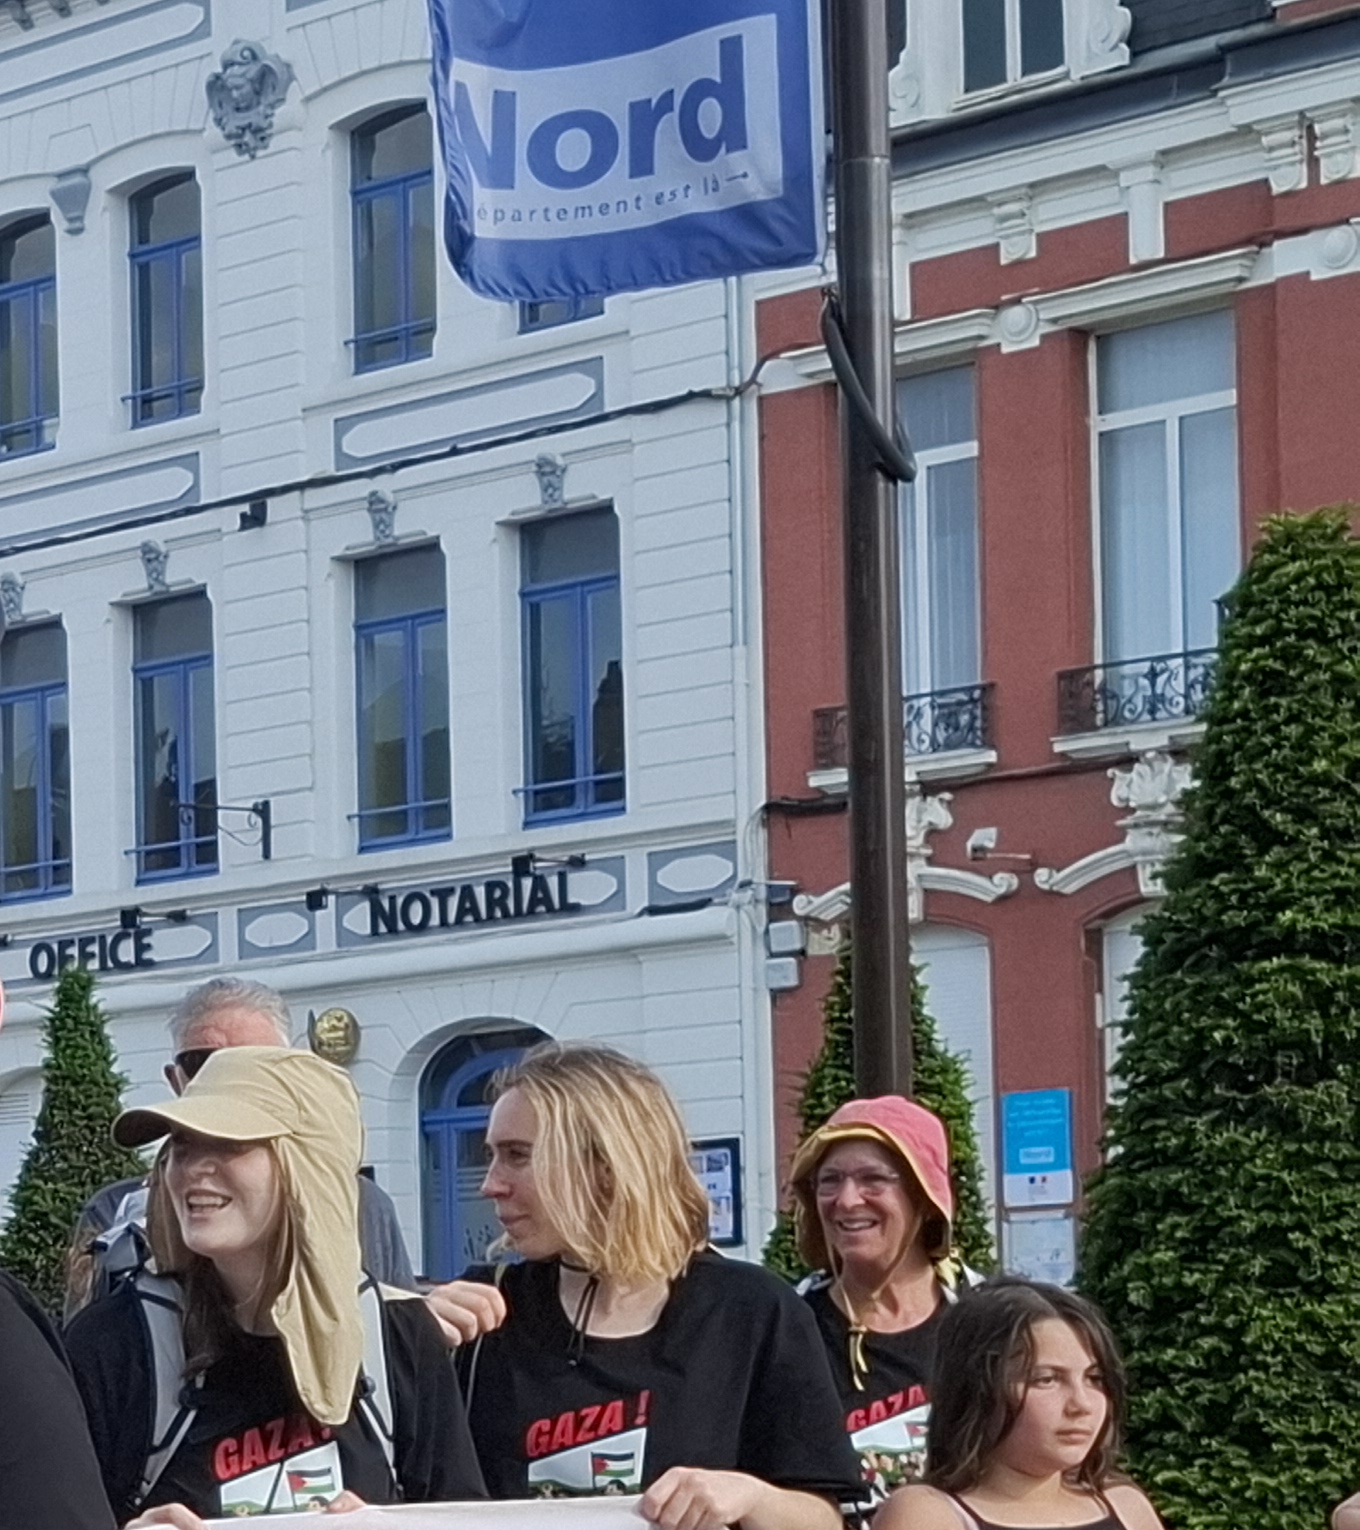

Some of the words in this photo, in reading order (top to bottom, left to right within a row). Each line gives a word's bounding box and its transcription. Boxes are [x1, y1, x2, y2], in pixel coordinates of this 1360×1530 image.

[453, 33, 748, 190] Nord
[474, 195, 643, 226] épartement
[655, 183, 691, 206] est
[29, 927, 154, 980] OFFICE
[369, 869, 580, 937] NOTARIAL
[526, 1399, 624, 1458] GAZA
[846, 1384, 926, 1432] GAZA
[215, 1416, 315, 1480] GAZA
